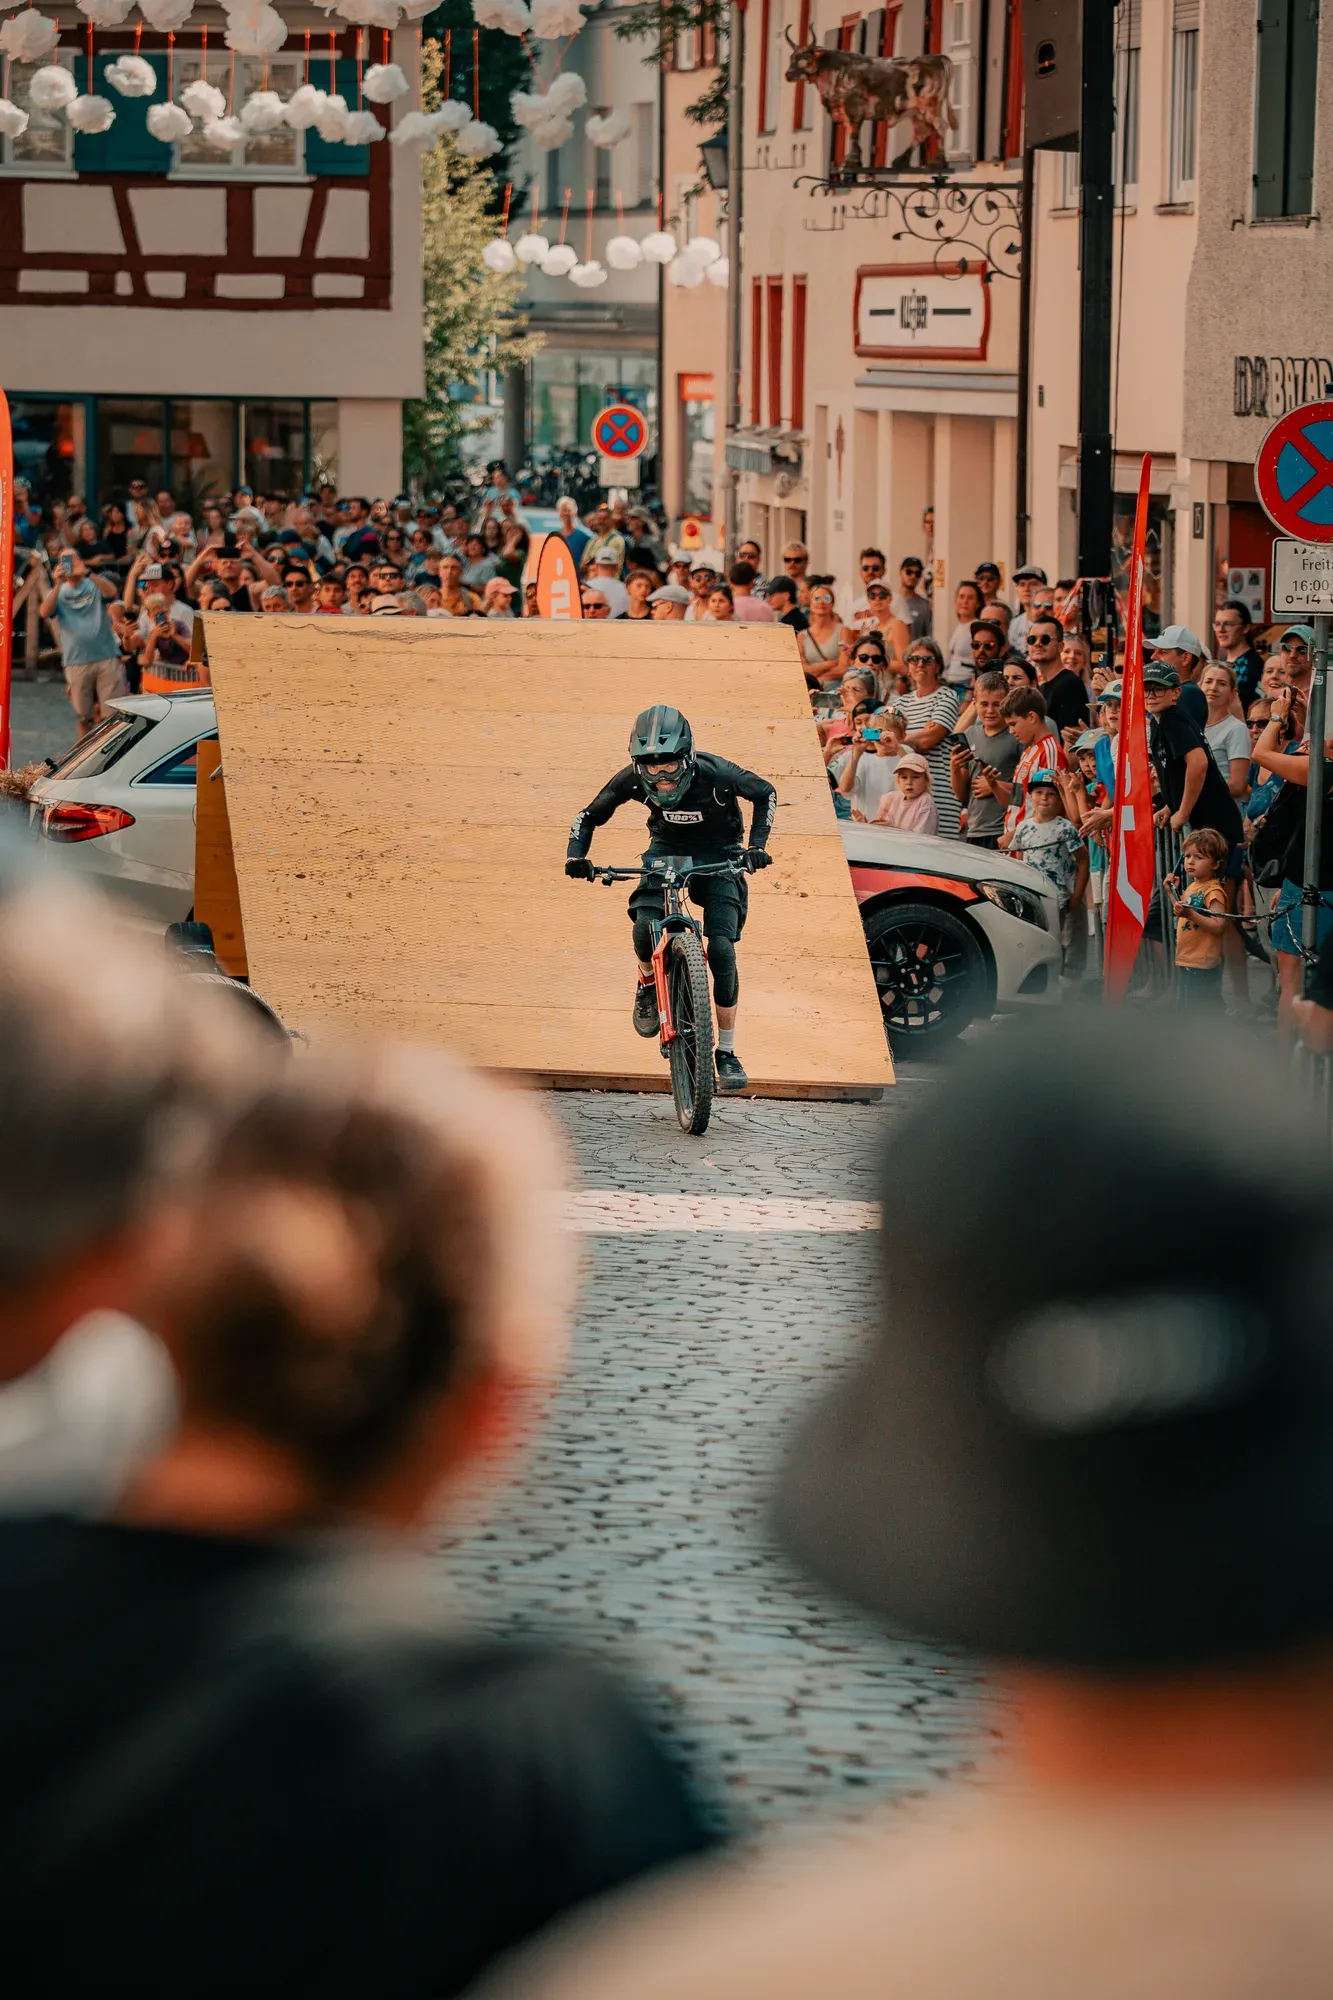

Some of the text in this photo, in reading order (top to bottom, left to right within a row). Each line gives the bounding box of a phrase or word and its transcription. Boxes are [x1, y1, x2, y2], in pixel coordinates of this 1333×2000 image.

[1302, 558, 1333, 571] Freit
[1293, 580, 1329, 592] 16:00
[667, 813, 699, 822] 100%
